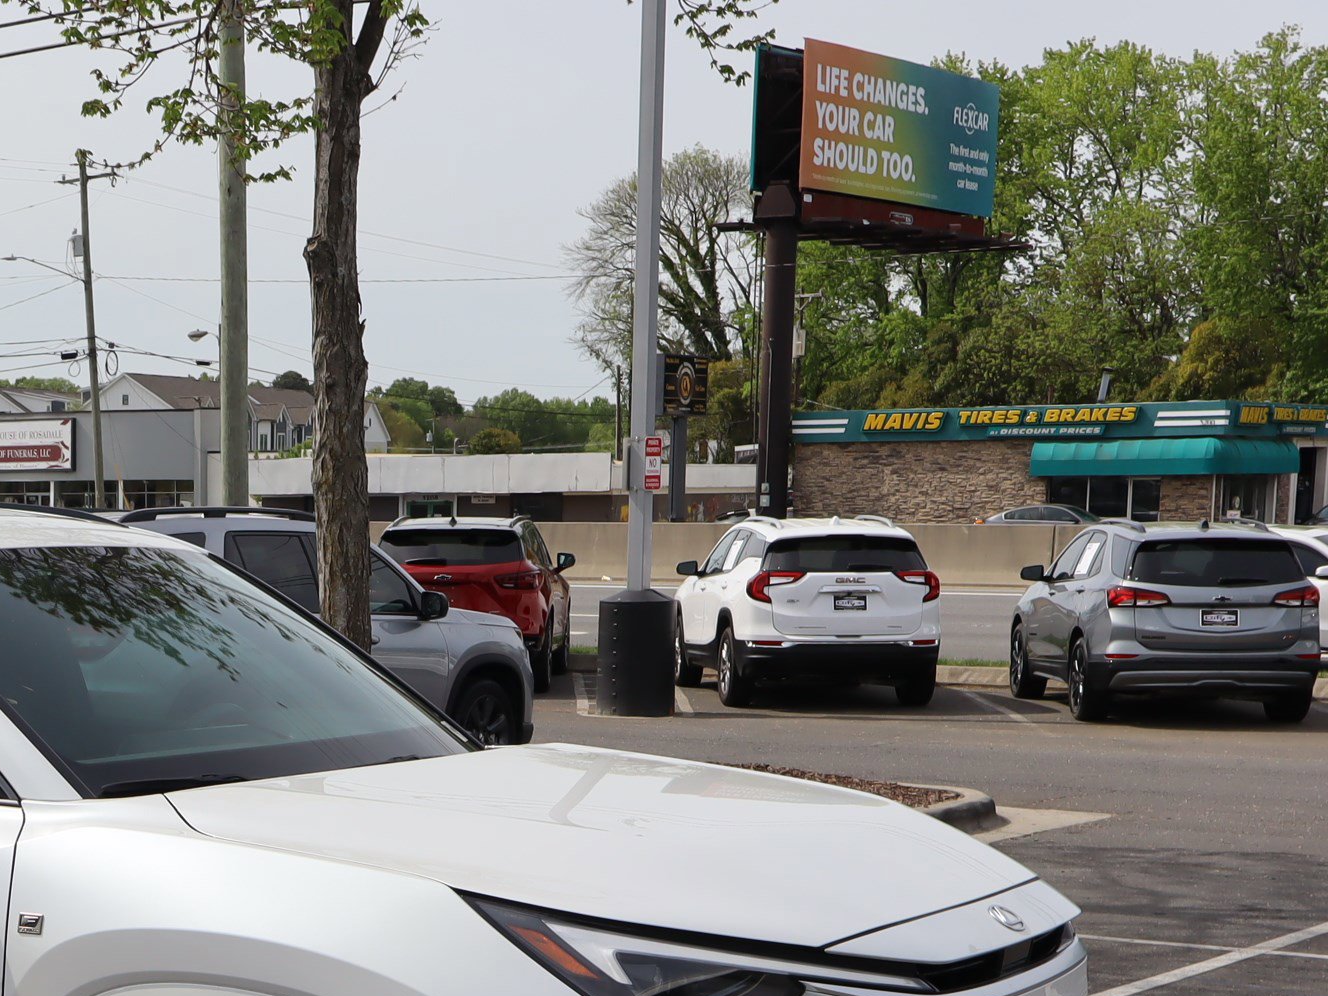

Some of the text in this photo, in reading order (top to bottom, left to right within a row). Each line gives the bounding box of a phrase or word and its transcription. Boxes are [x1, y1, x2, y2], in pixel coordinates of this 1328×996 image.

[816, 63, 929, 115] LIFE CHANGES.
[815, 100, 895, 143] YOUR CAR
[953, 106, 989, 132] FLEXCAR
[813, 137, 916, 183] SHOULD TOO.
[950, 143, 989, 164] The first and only
[956, 179, 978, 191] car lease
[864, 407, 1138, 430] MAVIS TIRES & BRAKES
[1239, 406, 1270, 424] MAVIS
[18, 431, 28, 440] OF
[29, 428, 63, 440] ROSADALE
[999, 427, 1056, 436] DISCOUNT
[1058, 427, 1102, 435] PRICES
[7, 449, 39, 459] FUNERALS,
[39, 448, 51, 457] LLC
[649, 458, 657, 468] NO
